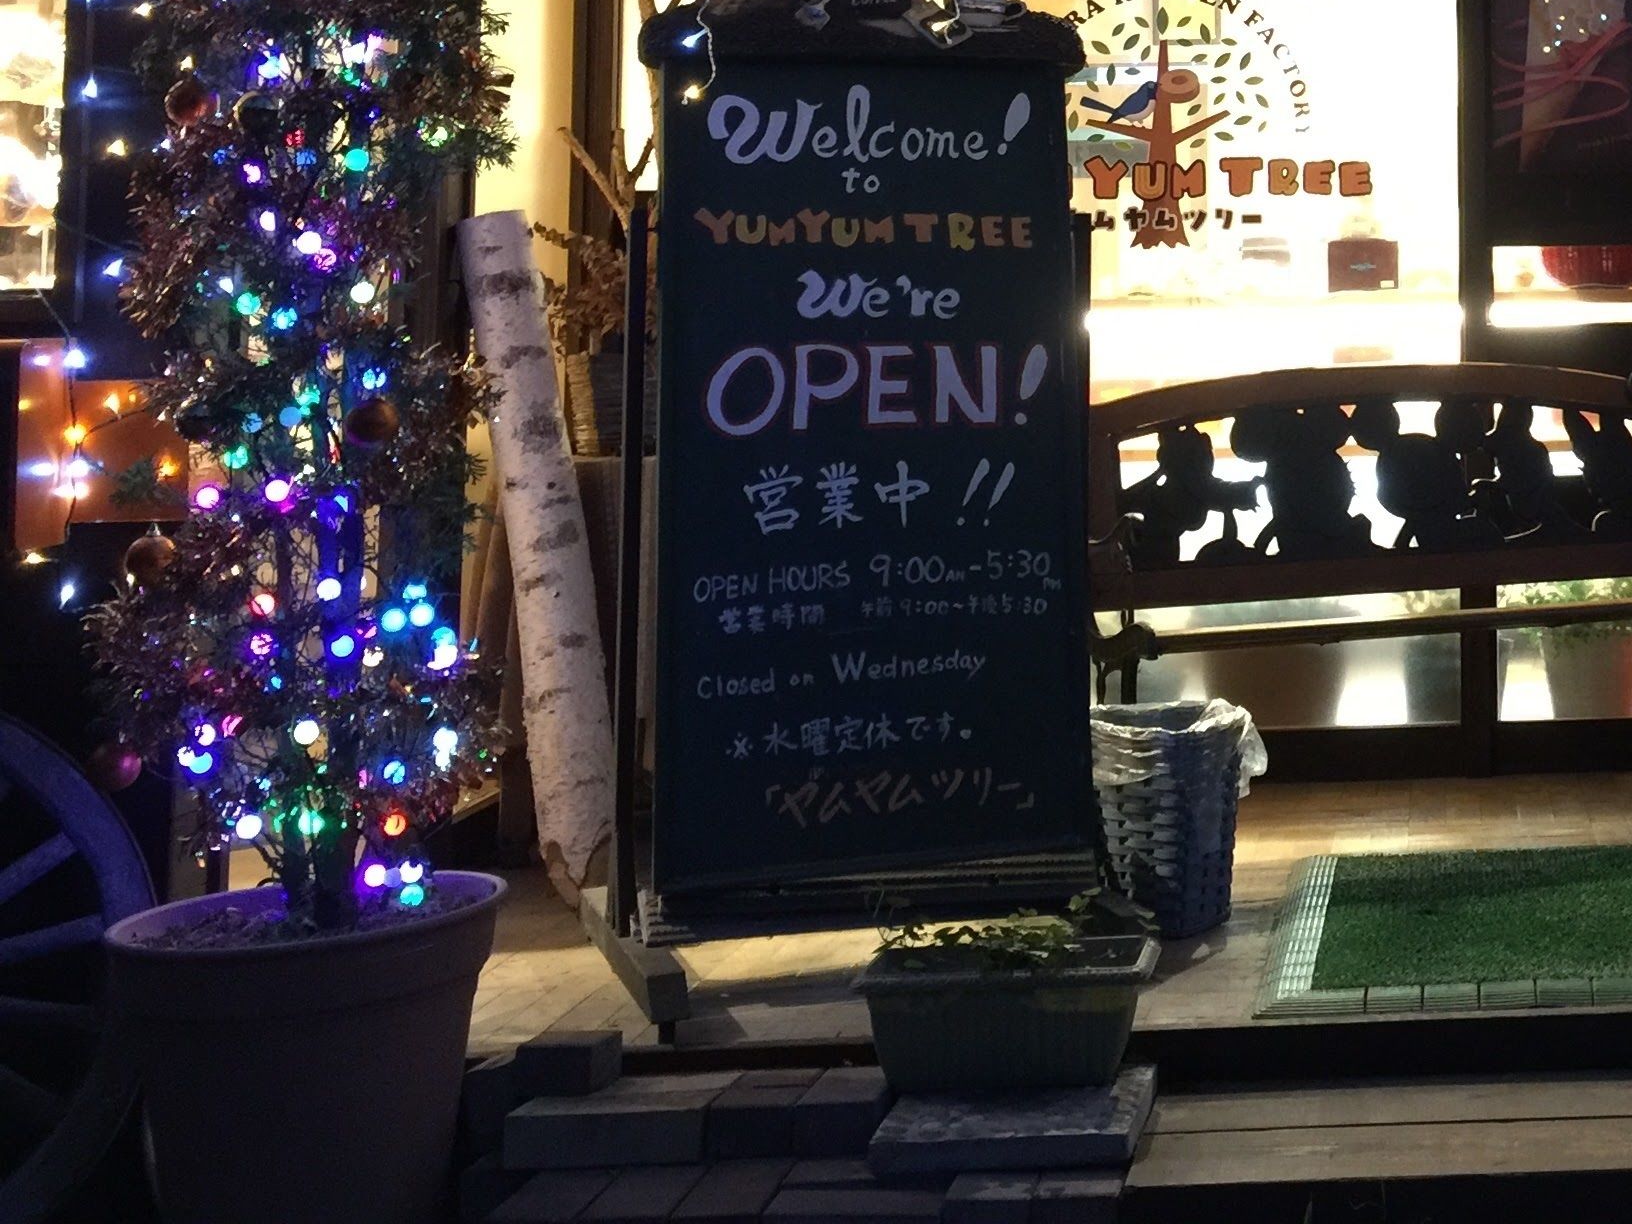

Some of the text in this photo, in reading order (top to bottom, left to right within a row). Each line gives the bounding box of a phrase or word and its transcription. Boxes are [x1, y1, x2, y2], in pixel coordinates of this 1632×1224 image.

[1243, 9, 1311, 133] FACTORY
[707, 84, 1031, 165] Welcome!
[841, 167, 881, 194] to
[1084, 154, 1207, 202] YUM
[1218, 156, 1374, 198] TREE
[904, 211, 1033, 252] TREE
[1072, 207, 1263, 232] ムヤムツリー
[796, 270, 961, 320] We're
[706, 343, 1049, 437] OPEN!
[693, 573, 760, 603] OPEN
[768, 560, 851, 595] HOURS
[717, 602, 825, 635] 営業時間
[697, 647, 987, 700] Closed on Wednesday
